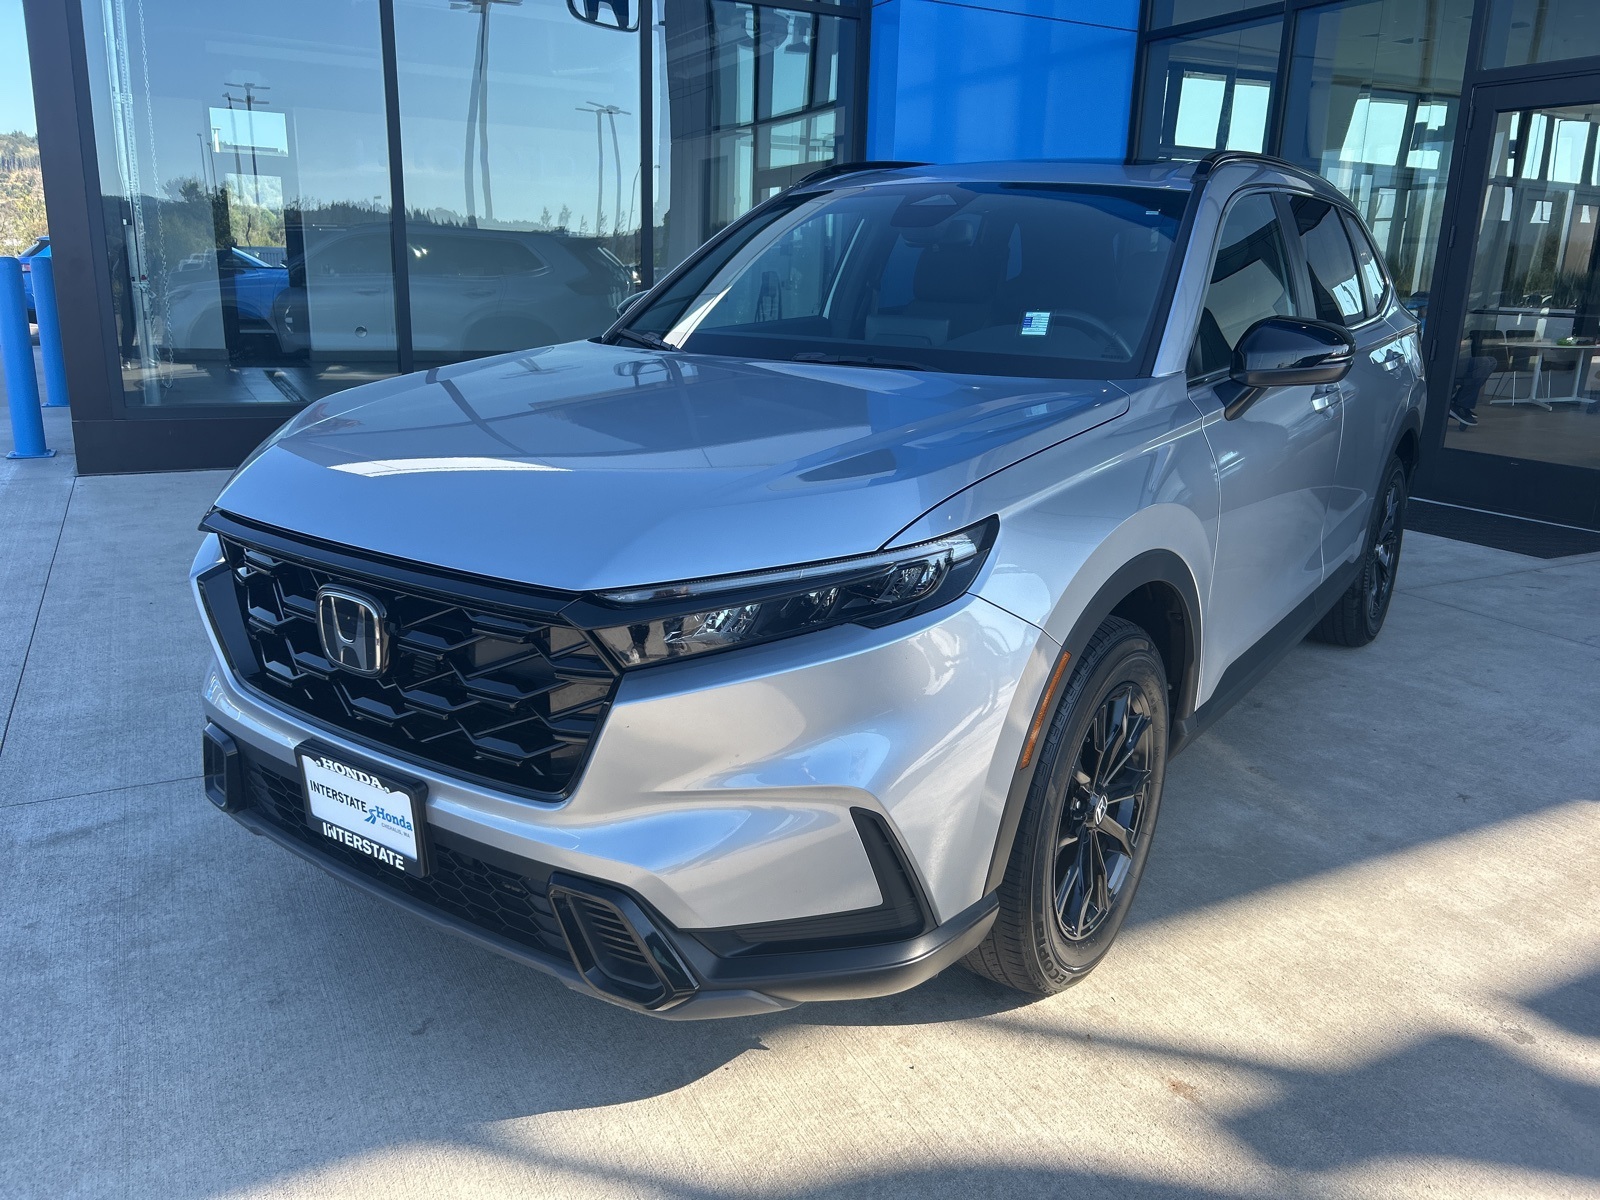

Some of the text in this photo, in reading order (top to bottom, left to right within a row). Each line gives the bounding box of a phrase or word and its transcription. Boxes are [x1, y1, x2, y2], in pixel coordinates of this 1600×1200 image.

[320, 757, 384, 790] HONDA
[309, 779, 413, 831] INTERSTATE Honda
[322, 821, 405, 871] INTERSTATE
